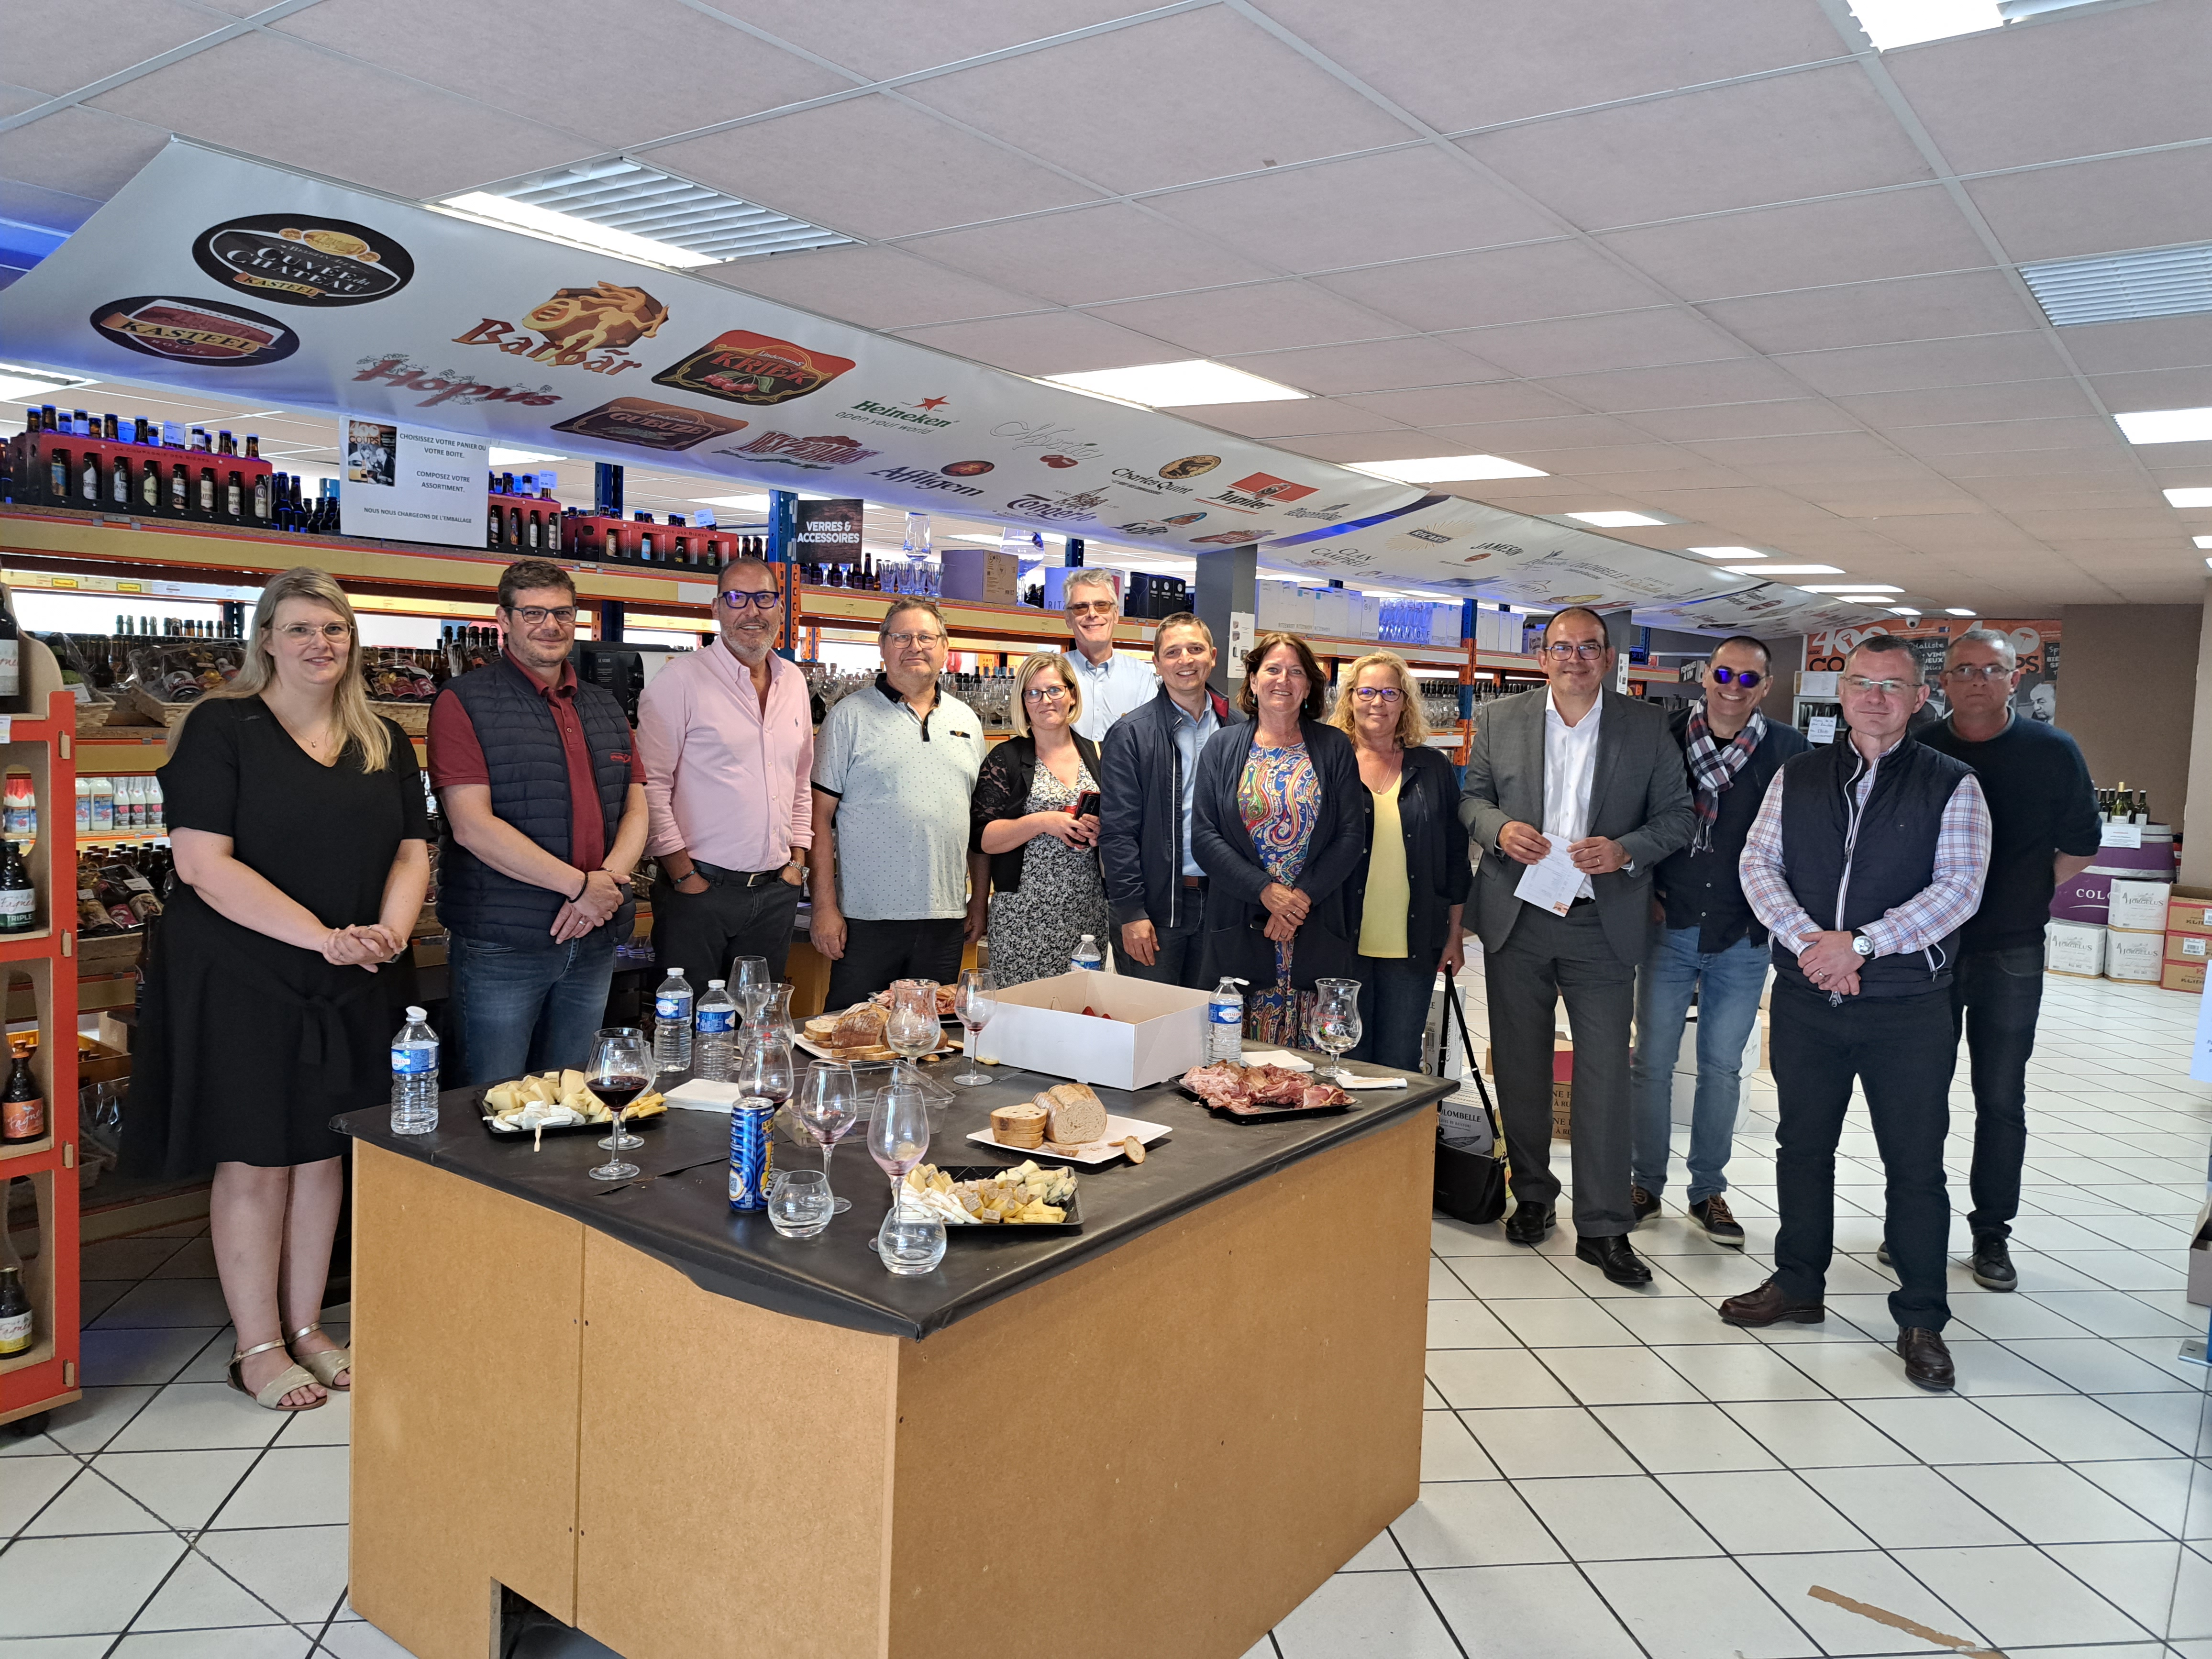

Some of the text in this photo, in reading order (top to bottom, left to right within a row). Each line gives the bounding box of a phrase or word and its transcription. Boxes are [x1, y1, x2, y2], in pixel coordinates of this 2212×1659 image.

[257, 248, 370, 286] CUVÉE du
[243, 277, 317, 293] KASTEEL
[118, 321, 252, 350] KASTEEL
[151, 339, 208, 355] ROUGE
[709, 352, 817, 385] KRIEK
[352, 359, 564, 407] Hopus
[851, 400, 952, 427] Heineken
[835, 411, 936, 435] open your world
[349, 436, 379, 444] COUPS
[399, 433, 434, 443] CHOISISSEZ
[435, 438, 455, 446] VOTRE
[457, 441, 477, 450] PANIER
[731, 431, 880, 464] DESPERADOS
[424, 447, 465, 458] VOTRE BOITE.
[416, 470, 450, 480] COMPOSEZ
[864, 466, 985, 497] Affligem
[1111, 468, 1194, 494] Charles Quint
[421, 482, 465, 493] ASSORTIMENT.
[1006, 494, 1098, 522] Tongerlo
[1206, 490, 1275, 509] Jupiler
[398, 511, 431, 519] CHARGEONS
[439, 515, 472, 523] L'EMBALLAGE
[806, 521, 852, 532] VERRES &
[796, 533, 860, 543] ACCESSOIRES
[1412, 530, 1449, 543] RICARD
[1311, 548, 1371, 568] CAMPBELL
[1339, 548, 1378, 562] CLAN
[1470, 542, 1524, 557] JAMESON
